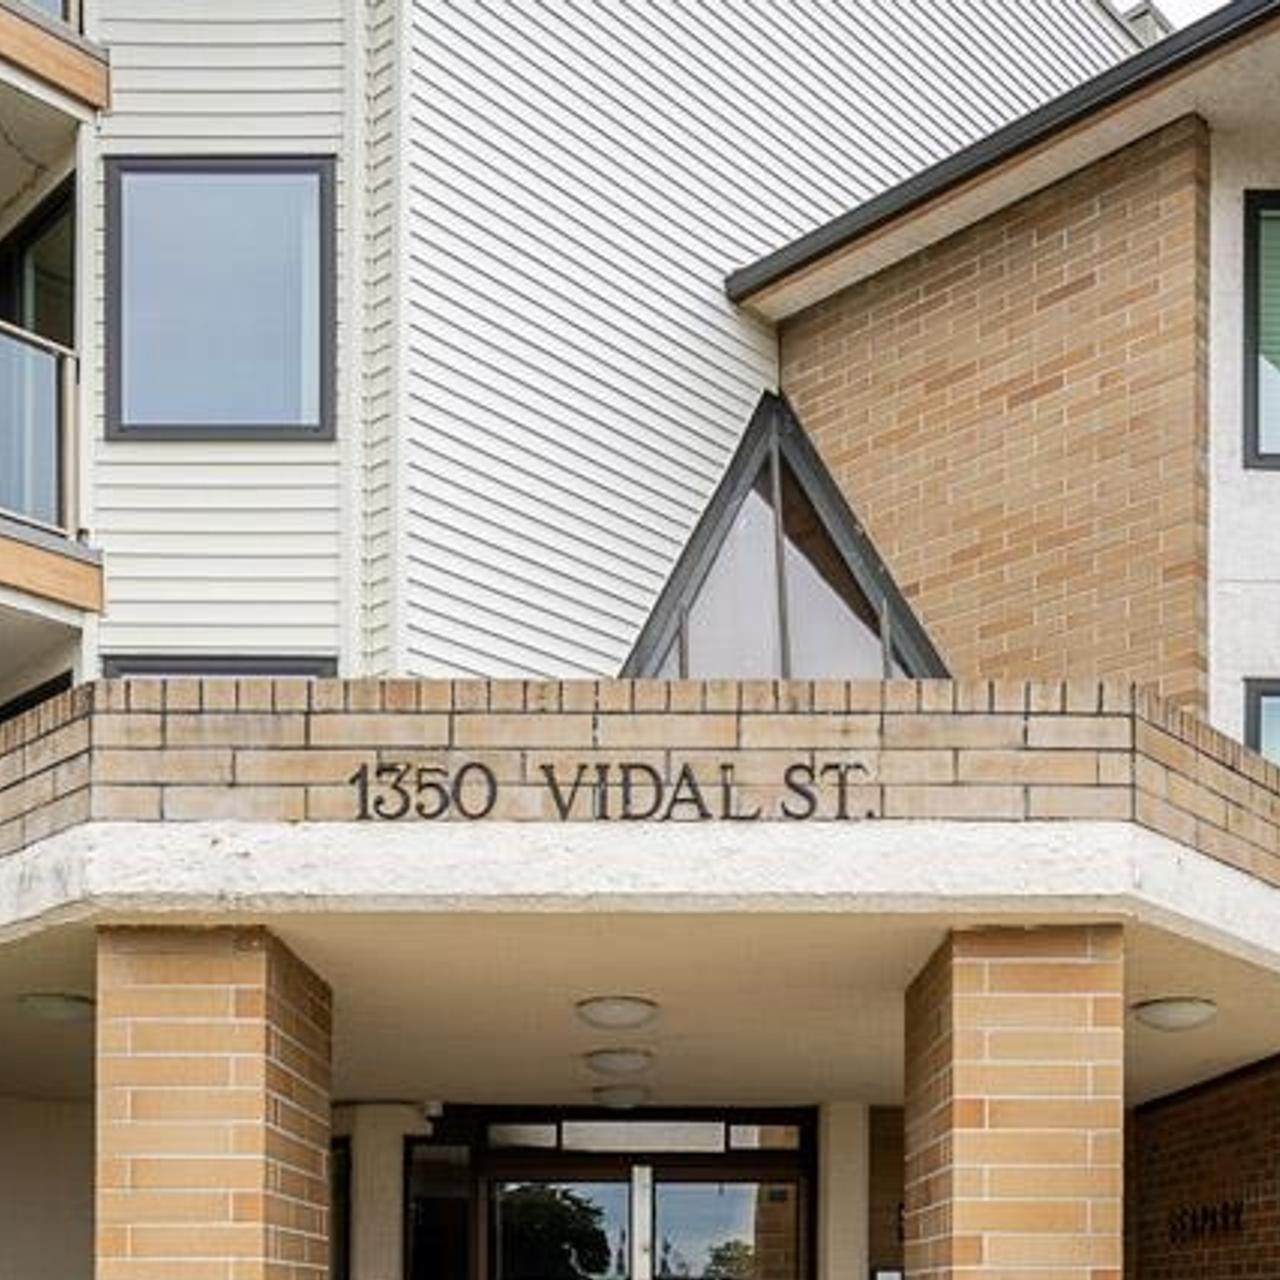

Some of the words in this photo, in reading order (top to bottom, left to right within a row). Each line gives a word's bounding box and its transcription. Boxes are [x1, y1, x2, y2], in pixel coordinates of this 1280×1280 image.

[348, 762, 498, 820] 1350
[539, 762, 762, 821] VIDAL
[780, 762, 877, 820] ST.
